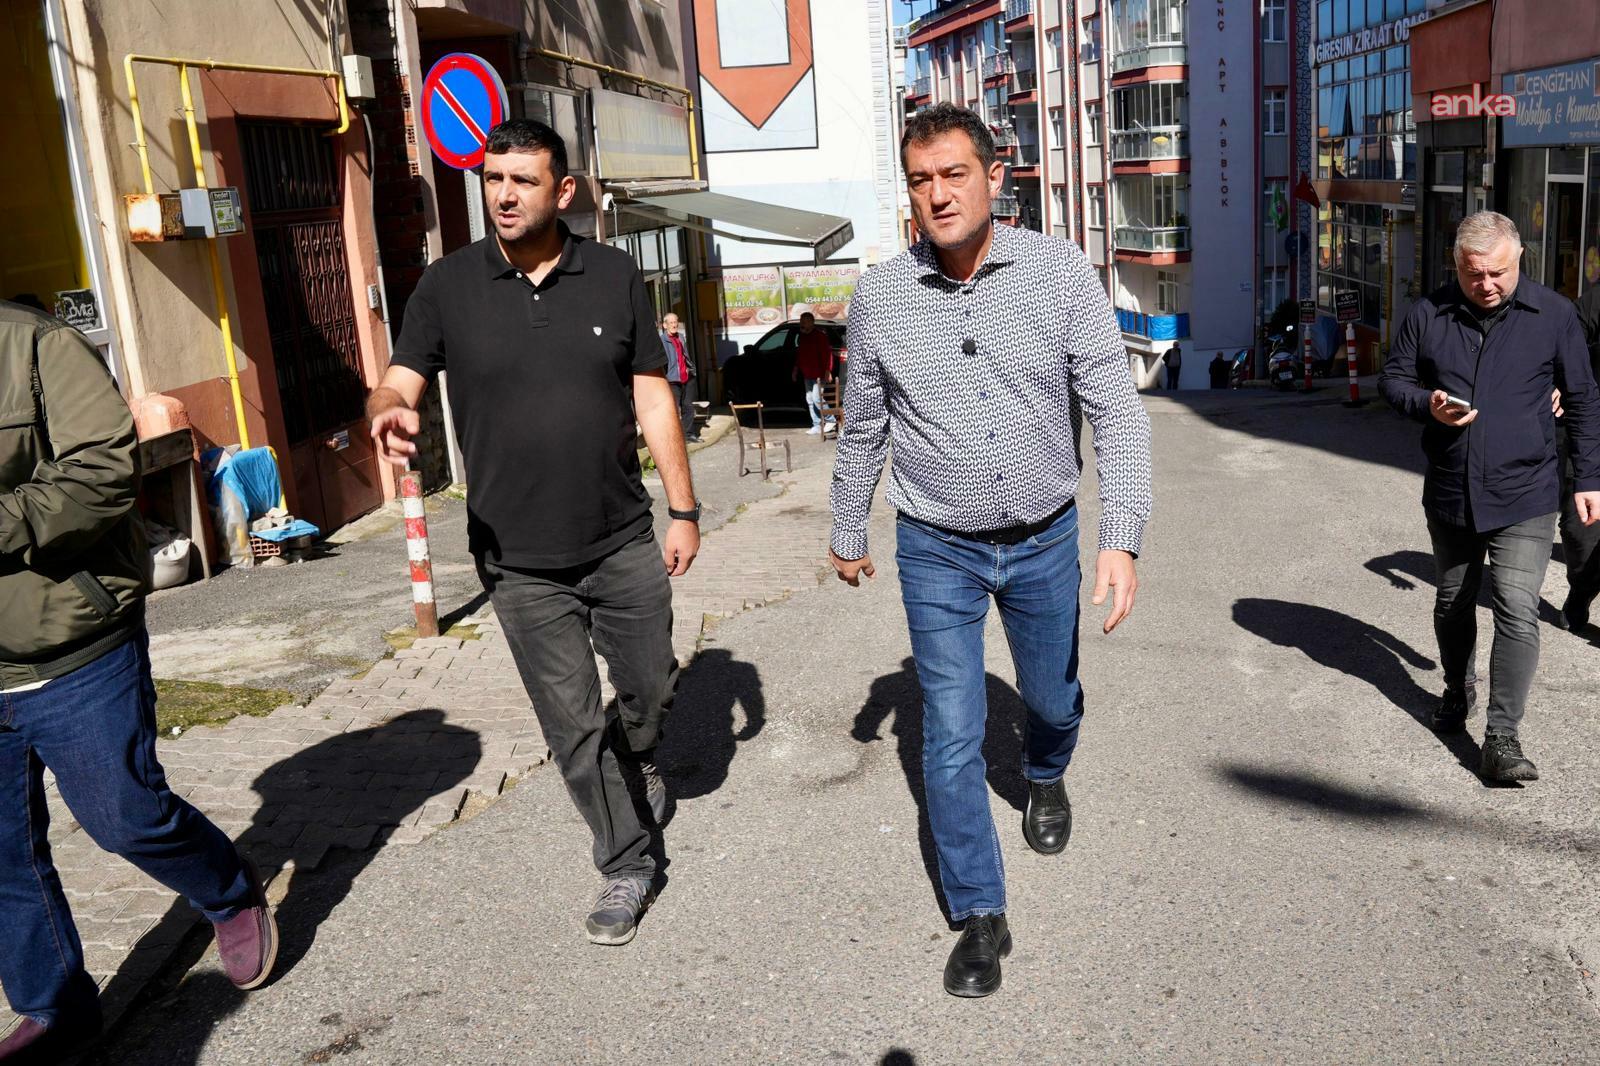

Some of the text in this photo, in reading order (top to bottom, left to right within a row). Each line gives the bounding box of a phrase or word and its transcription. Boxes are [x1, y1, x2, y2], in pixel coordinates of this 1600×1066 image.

[1316, 35, 1353, 63] GİRESUN
[1354, 22, 1392, 52] ZİRAAT
[1217, 57, 1226, 93] APT
[1526, 68, 1590, 96] CENGİZHAN
[1516, 96, 1552, 133] Mobilya
